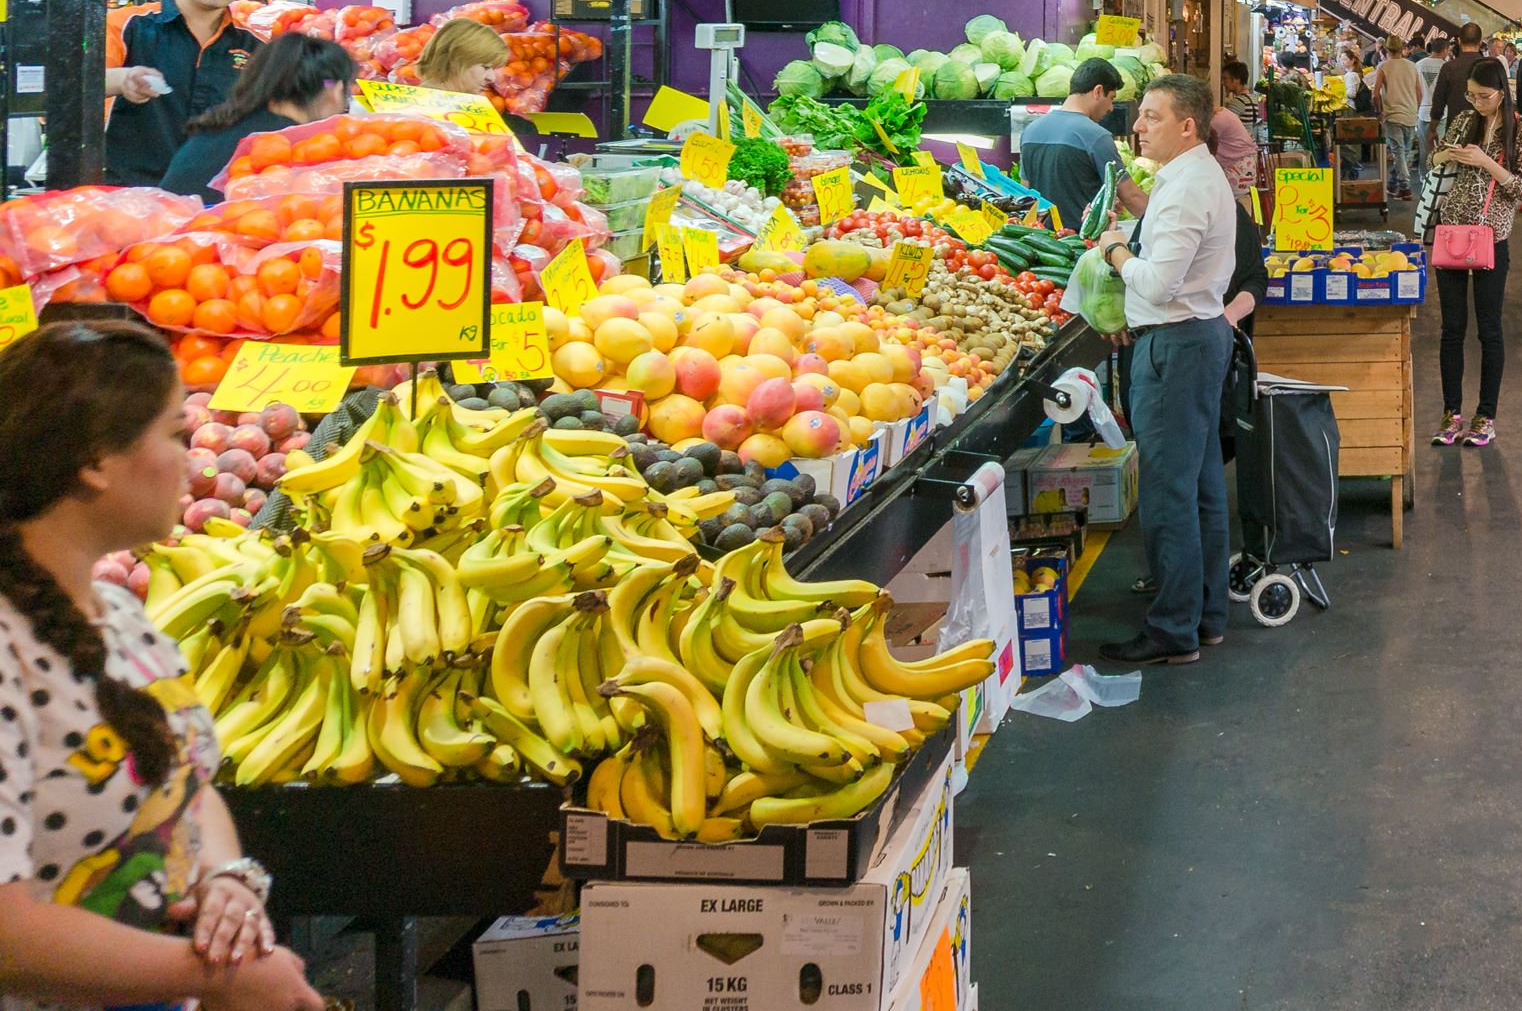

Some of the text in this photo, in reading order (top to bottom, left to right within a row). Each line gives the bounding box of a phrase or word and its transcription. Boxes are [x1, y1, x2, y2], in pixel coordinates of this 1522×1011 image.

[1277, 169, 1325, 183] Special
[357, 188, 486, 212] BANANAS
[1278, 185, 1302, 224] 2
[490, 309, 537, 326] ocado
[257, 343, 335, 364] Peache
[701, 899, 763, 913] EX LARGE
[706, 977, 747, 994] 15 KG
[828, 984, 872, 996] CLASS 1
